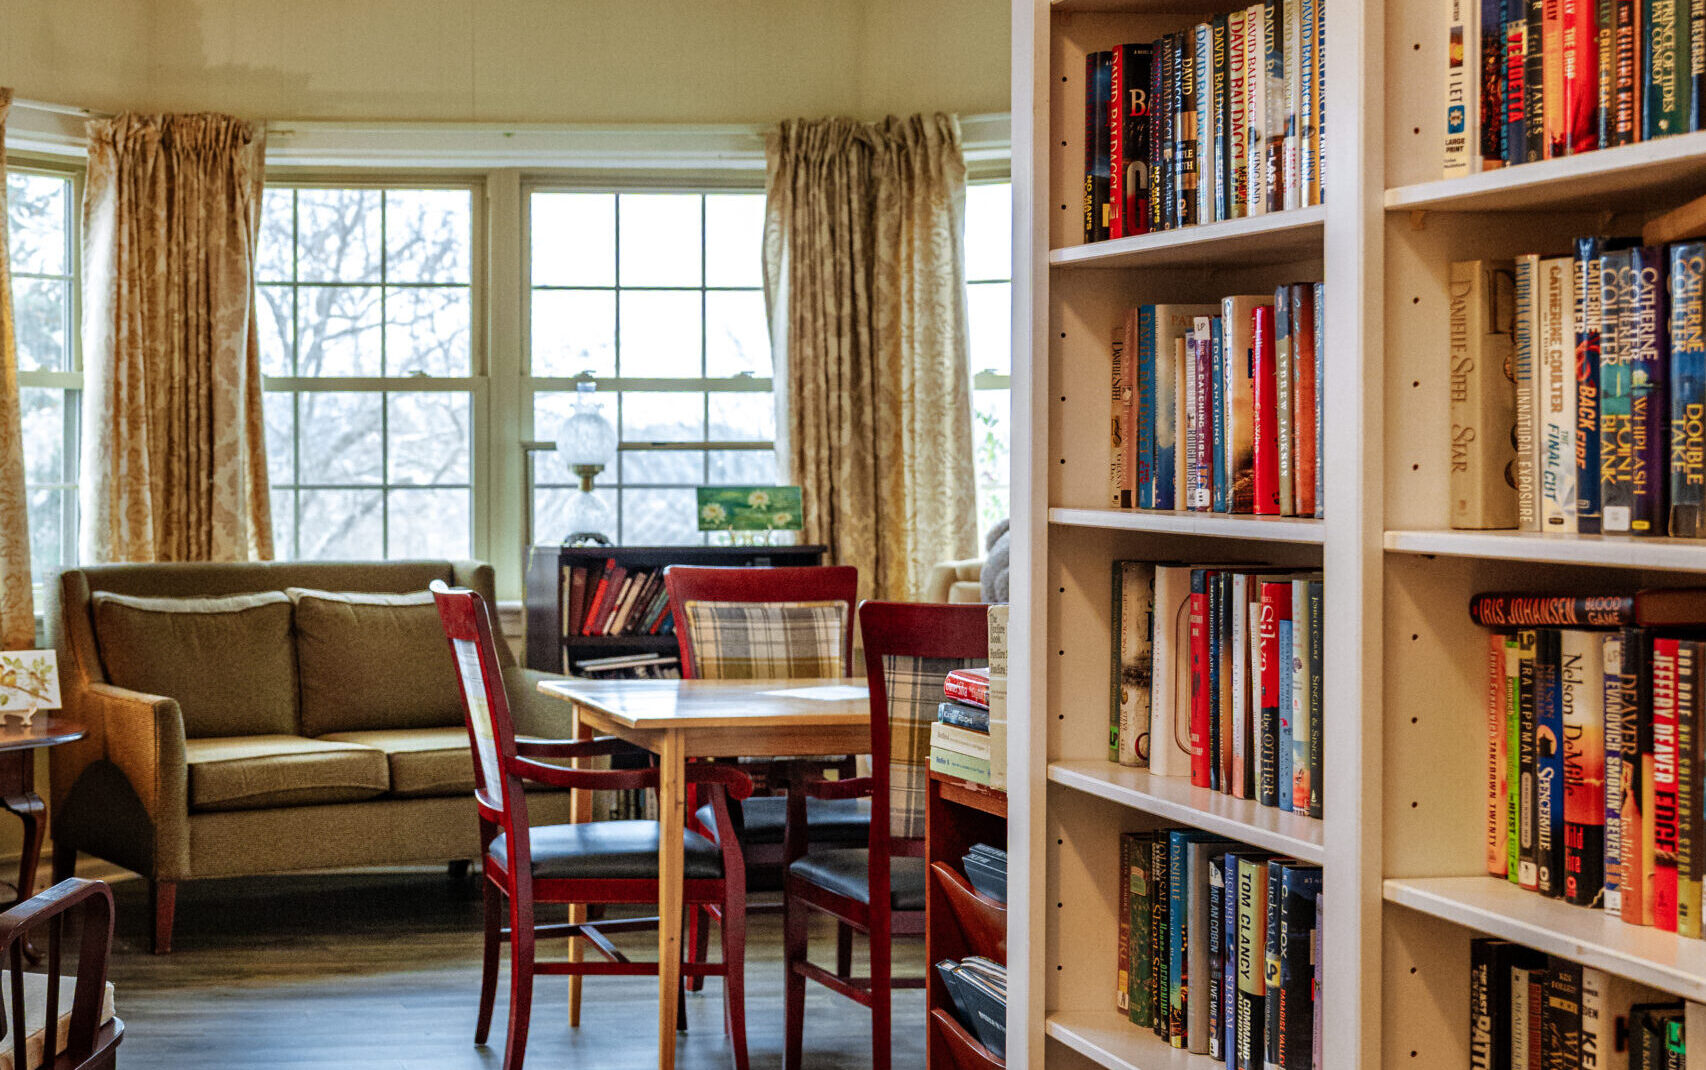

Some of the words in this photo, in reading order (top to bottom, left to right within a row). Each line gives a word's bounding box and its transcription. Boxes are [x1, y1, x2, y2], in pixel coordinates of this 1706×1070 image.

[1248, 11, 1256, 53] DAVID
[1264, 6, 1274, 54] DAVID
[1284, 1, 1293, 40] DAVID
[1300, 0, 1312, 40] DAVID
[1620, 6, 1630, 22] THE
[1652, 0, 1662, 24] PAT
[1662, 0, 1675, 50] PRINCE
[1163, 38, 1172, 77] DAVID
[1196, 30, 1207, 76] DAVID
[1214, 26, 1224, 68] DAVID
[1230, 20, 1244, 72] DAVID
[1564, 28, 1576, 47] THE
[1600, 28, 1610, 74] CRIME
[1616, 26, 1633, 88] KILLING
[1652, 27, 1662, 87] CONROY
[1662, 52, 1675, 71] OF
[1691, 20, 1704, 76] REVERSAL
[1110, 51, 1118, 103] DAVID
[1182, 58, 1192, 95] DAVID
[1284, 44, 1292, 109] BALDACCI
[1300, 44, 1312, 118] BALDACCI
[1508, 32, 1524, 123] VENDETTA
[1564, 50, 1575, 80] DROP
[1163, 80, 1172, 141] BALDACCI
[1214, 72, 1224, 137] BALDACCI
[1248, 58, 1256, 122] BALDACCI
[1450, 82, 1462, 102] LET
[1533, 84, 1542, 136] JAMES
[1600, 77, 1610, 108] BEAT
[1616, 91, 1632, 132] KIND
[1662, 72, 1675, 112] TIDES
[1196, 79, 1206, 157] BALDACCI
[1230, 76, 1244, 158] BALDACCI
[1110, 108, 1118, 189] BALDACCI
[1252, 151, 1260, 173] KING
[1306, 149, 1316, 184] FIRST
[1086, 175, 1093, 192] NO
[1154, 166, 1160, 183] NO
[1238, 166, 1247, 204] MEMORY
[1252, 176, 1260, 204] AND
[1268, 156, 1276, 194] LAST
[1516, 263, 1530, 315] PATRICIA
[1548, 266, 1562, 347] CATHERINE
[1574, 261, 1586, 334] COULTER
[1588, 260, 1600, 334] CATHERINE
[1639, 267, 1658, 360] CATHERINE
[1672, 259, 1687, 354] COULTER
[1686, 256, 1704, 353] CATHERINE
[1140, 312, 1150, 364] DAVID
[1450, 280, 1472, 352] DANIELLE
[1601, 268, 1618, 366] COULTER
[1618, 265, 1630, 366] CATHERINE
[1628, 268, 1640, 360] COULTER
[1112, 342, 1123, 378] DANIELLE
[1517, 320, 1531, 381] CORNWELL
[1280, 352, 1288, 410] ANDREW
[1451, 355, 1474, 404] STEEL
[1550, 350, 1563, 412] COULTER
[1140, 370, 1150, 453] BALDACCI
[1518, 388, 1532, 455] UNNATURAL
[1578, 385, 1596, 431] BACK
[1188, 430, 1196, 460] ROUGH
[1280, 418, 1288, 477] JACKSON
[1452, 425, 1475, 474] STAR
[1547, 424, 1560, 468] FINAL
[1560, 431, 1568, 446] THE
[1576, 430, 1586, 469] FIRE
[1601, 414, 1616, 484] BLANK
[1616, 414, 1632, 482] POINT
[1632, 396, 1648, 495] WHIPLASH
[1672, 414, 1686, 474] TAKE
[1686, 403, 1704, 485] DOUBLE
[1187, 462, 1196, 492] MUSIC
[1519, 461, 1533, 522] EXPOSURE
[1543, 470, 1556, 502] CUT
[1480, 598, 1505, 624] IRIS
[1508, 598, 1578, 624] JOHANSEN
[1584, 597, 1622, 610] BLOOD
[1588, 612, 1620, 624] GAME
[1260, 604, 1275, 671] Silva
[1562, 654, 1584, 714] Nelson
[1654, 652, 1673, 718] JEFFERY
[1678, 649, 1690, 676] BOB
[1312, 675, 1320, 714] SINGLE
[1544, 664, 1554, 718] NELSON
[1606, 681, 1620, 750] EVANOVICH
[1620, 674, 1636, 754] DEAVER
[1678, 682, 1690, 716] DOLE
[1264, 714, 1272, 731] the
[1312, 718, 1319, 727] &
[1521, 694, 1532, 764] LIPPMAN
[1678, 724, 1690, 745] ONE
[1264, 734, 1274, 796] OTHER
[1312, 730, 1320, 769] SINGLE
[1563, 724, 1584, 797] DeMille
[1654, 724, 1673, 783] DEAVER
[1538, 766, 1554, 850] SPENCERVILLE
[1606, 756, 1620, 813] SMOKIN'
[1678, 758, 1690, 830] SOLDIER'S
[1488, 804, 1496, 848] TWENTY
[1606, 817, 1620, 859] SEVEN
[1655, 790, 1676, 852] EDGE
[1158, 841, 1166, 878] JOHN
[1172, 844, 1181, 902] DANIELLE
[1678, 838, 1690, 880] STORY
[1241, 872, 1251, 906] TOM
[1268, 877, 1278, 918] Lucky
[1281, 885, 1288, 900] C.
[1281, 904, 1288, 915] J.
[1152, 904, 1160, 950] Short
[1210, 920, 1218, 952] COBEN
[1240, 914, 1251, 981] CLANCY
[1152, 956, 1160, 1006] Straw
[1210, 980, 1218, 999] LIVE
[1480, 964, 1488, 986] THE
[1480, 987, 1488, 1014] LAST
[1242, 998, 1250, 1060] COMMAND
